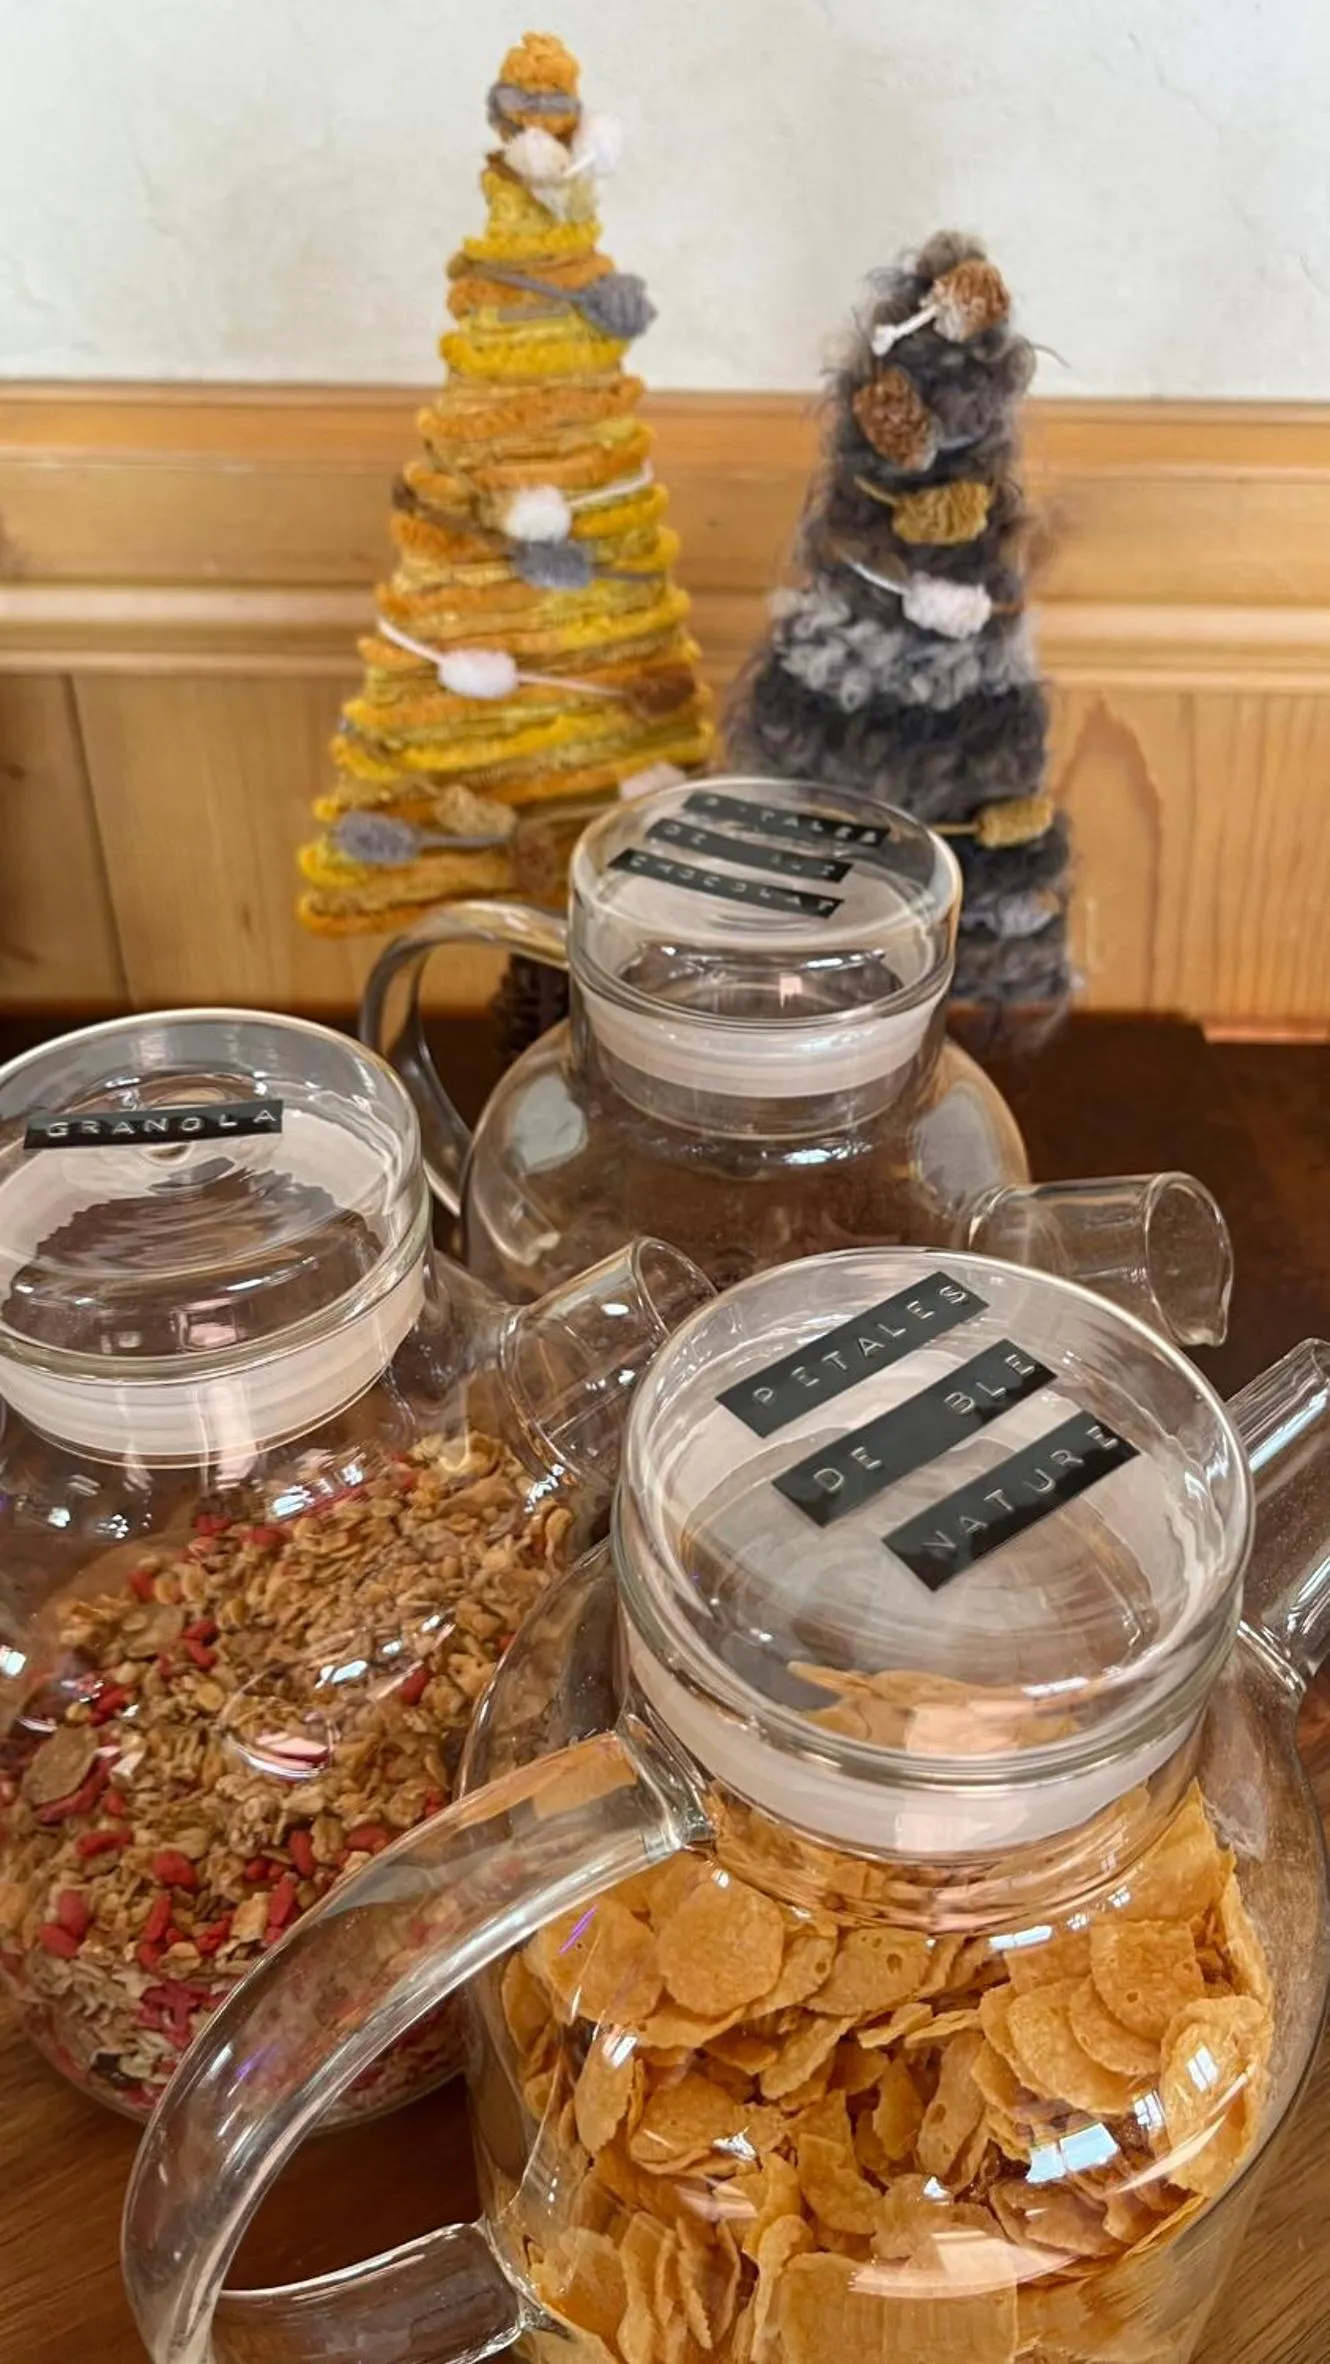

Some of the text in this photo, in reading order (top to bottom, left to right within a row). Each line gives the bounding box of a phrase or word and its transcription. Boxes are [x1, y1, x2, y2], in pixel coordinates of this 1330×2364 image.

[46, 1109, 277, 1138] GRANOLA
[752, 1285, 969, 1405] PETALES
[812, 1352, 1036, 1494] DE BLE
[921, 1425, 1119, 1554] NATURE
